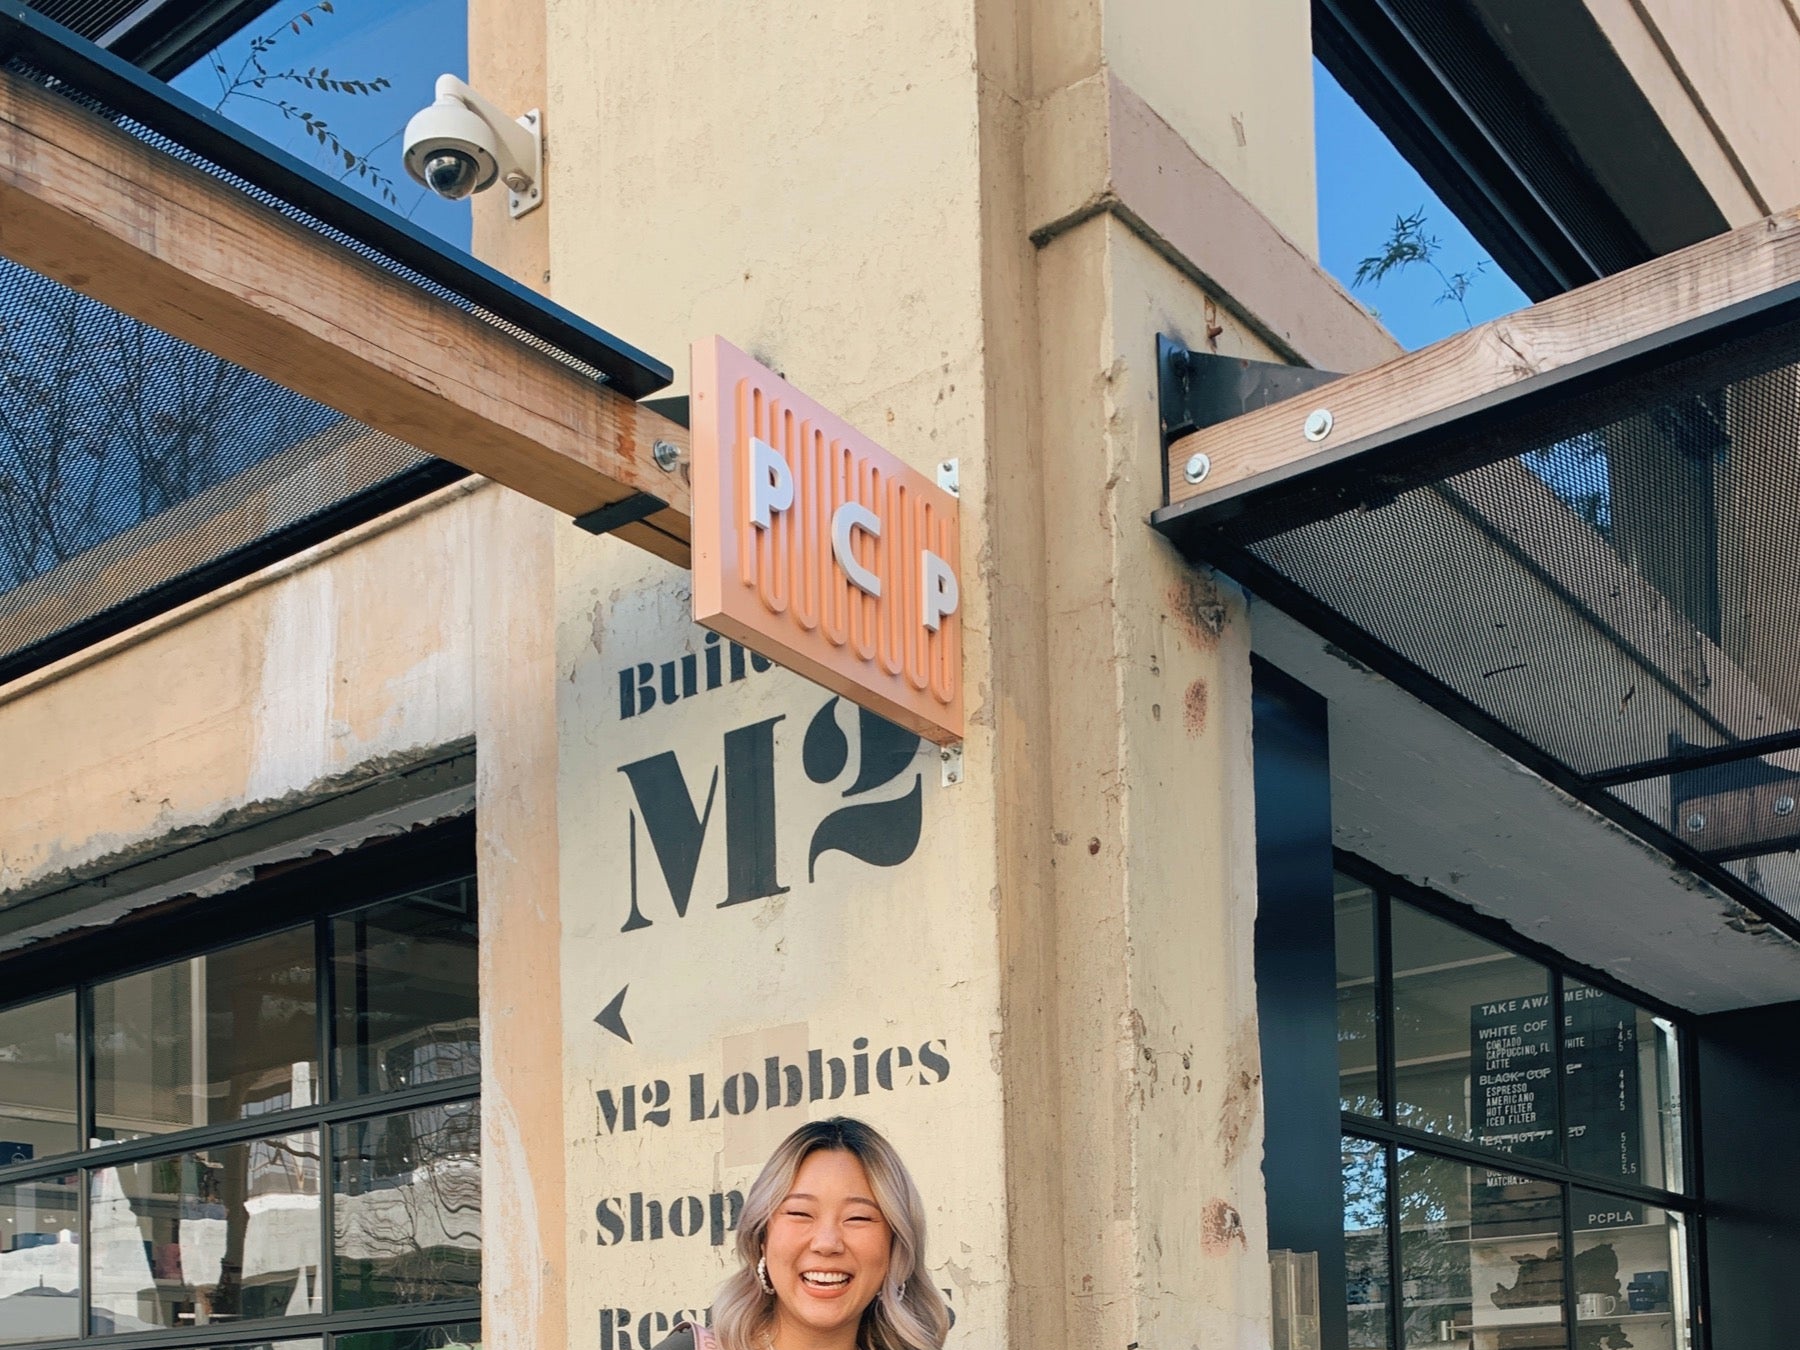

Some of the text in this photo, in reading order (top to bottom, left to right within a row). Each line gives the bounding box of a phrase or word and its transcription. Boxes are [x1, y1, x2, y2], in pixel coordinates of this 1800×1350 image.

[618, 631, 779, 720] Buil
[617, 695, 922, 933] M2
[1481, 1001, 1517, 1016] TAKE
[1479, 1024, 1517, 1039] WHITE
[1486, 1036, 1521, 1051] CORTADO
[1486, 1058, 1510, 1071] LATTE
[1479, 1071, 1519, 1086] BLACK
[596, 1037, 950, 1137] M2 Lobbies
[1486, 1083, 1527, 1098] ESPRESSO
[1486, 1092, 1534, 1108] AMERICANO
[1486, 1106, 1501, 1117] HOT
[1505, 1102, 1533, 1115] FILTER
[1486, 1116, 1505, 1127] ICED
[1508, 1112, 1536, 1125] FILTER
[1479, 1135, 1503, 1146] TEA
[1486, 1175, 1518, 1187] MATCHA
[596, 1189, 744, 1246] Shop
[1588, 1211, 1634, 1225] PCPLA
